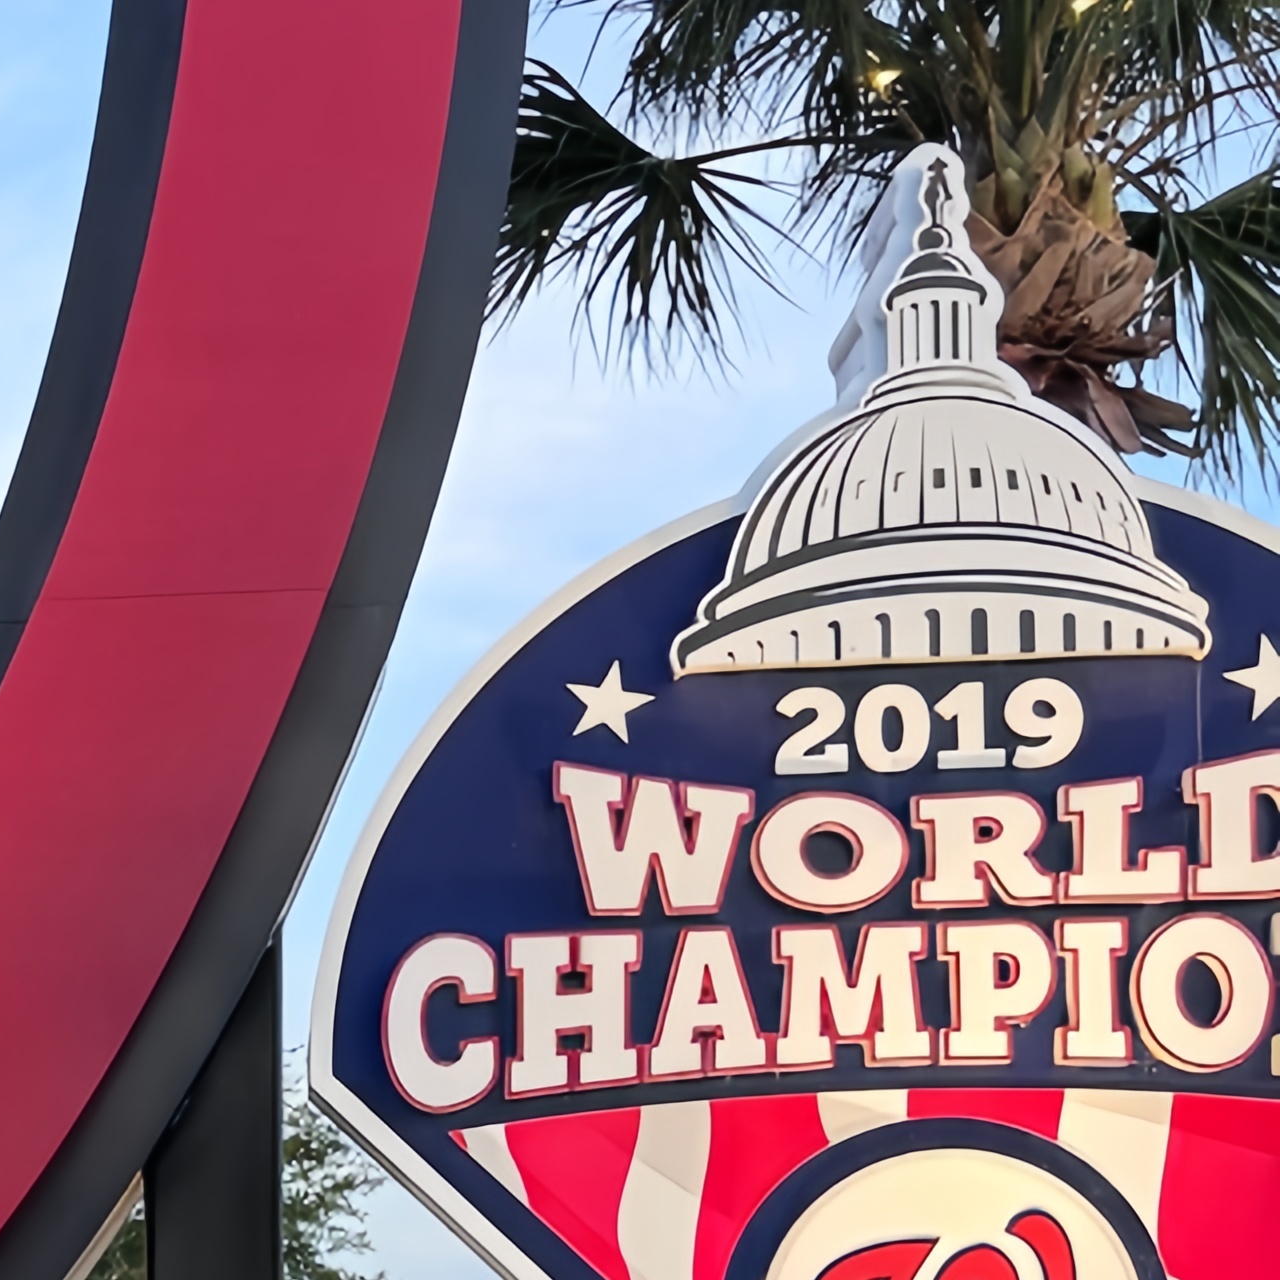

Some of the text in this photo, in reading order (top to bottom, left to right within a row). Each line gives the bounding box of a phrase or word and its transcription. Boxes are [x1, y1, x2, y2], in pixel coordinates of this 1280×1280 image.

[774, 679, 1084, 775] 2019
[552, 749, 1280, 916] WORLD
[382, 912, 1280, 1114] CHAMPIO
